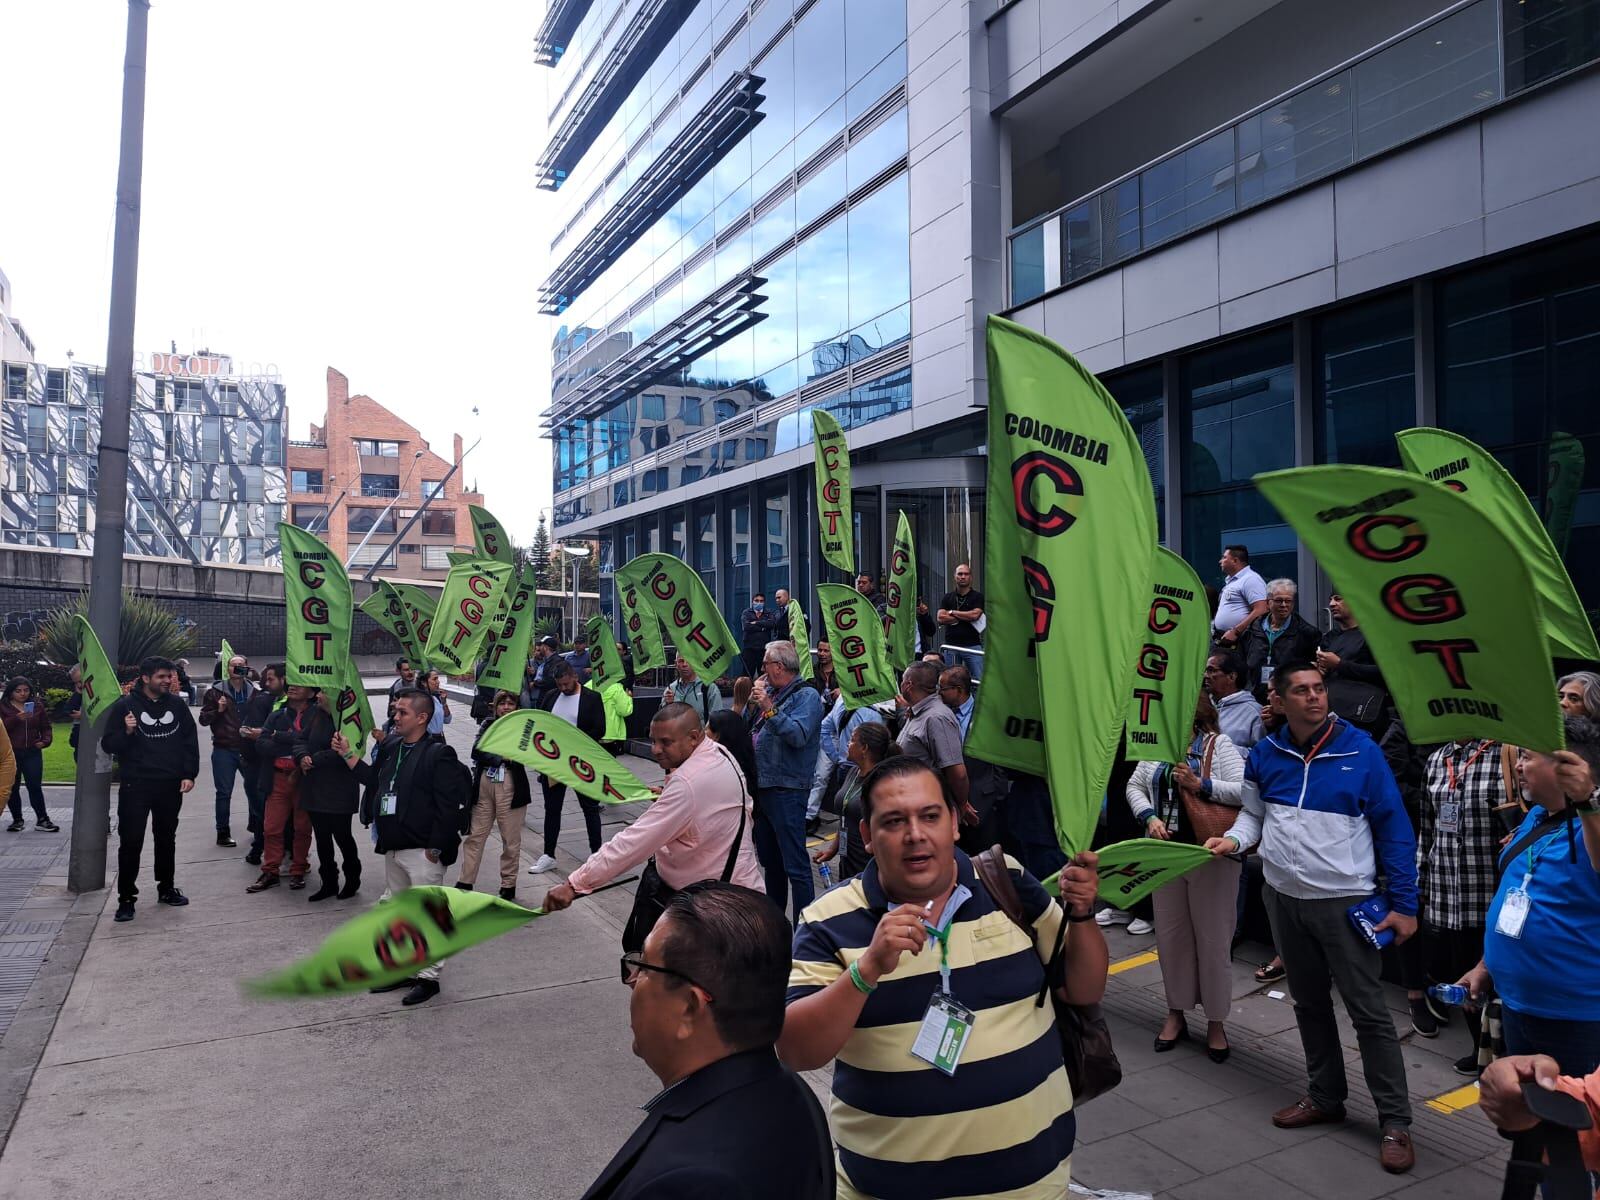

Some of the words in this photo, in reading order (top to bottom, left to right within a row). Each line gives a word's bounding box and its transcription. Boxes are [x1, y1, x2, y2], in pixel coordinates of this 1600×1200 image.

[1004, 412, 1109, 466] COLOMBIA
[823, 445, 842, 536] CGT
[299, 561, 332, 661] CGT
[454, 575, 492, 648] CGT
[652, 573, 714, 651] CGT
[1346, 514, 1480, 690] CGT
[299, 664, 333, 676] OFICIAL
[835, 607, 868, 687] CGT
[1131, 597, 1182, 725] CGT
[1427, 698, 1503, 722] OFICIAL
[532, 731, 626, 800] CGT
